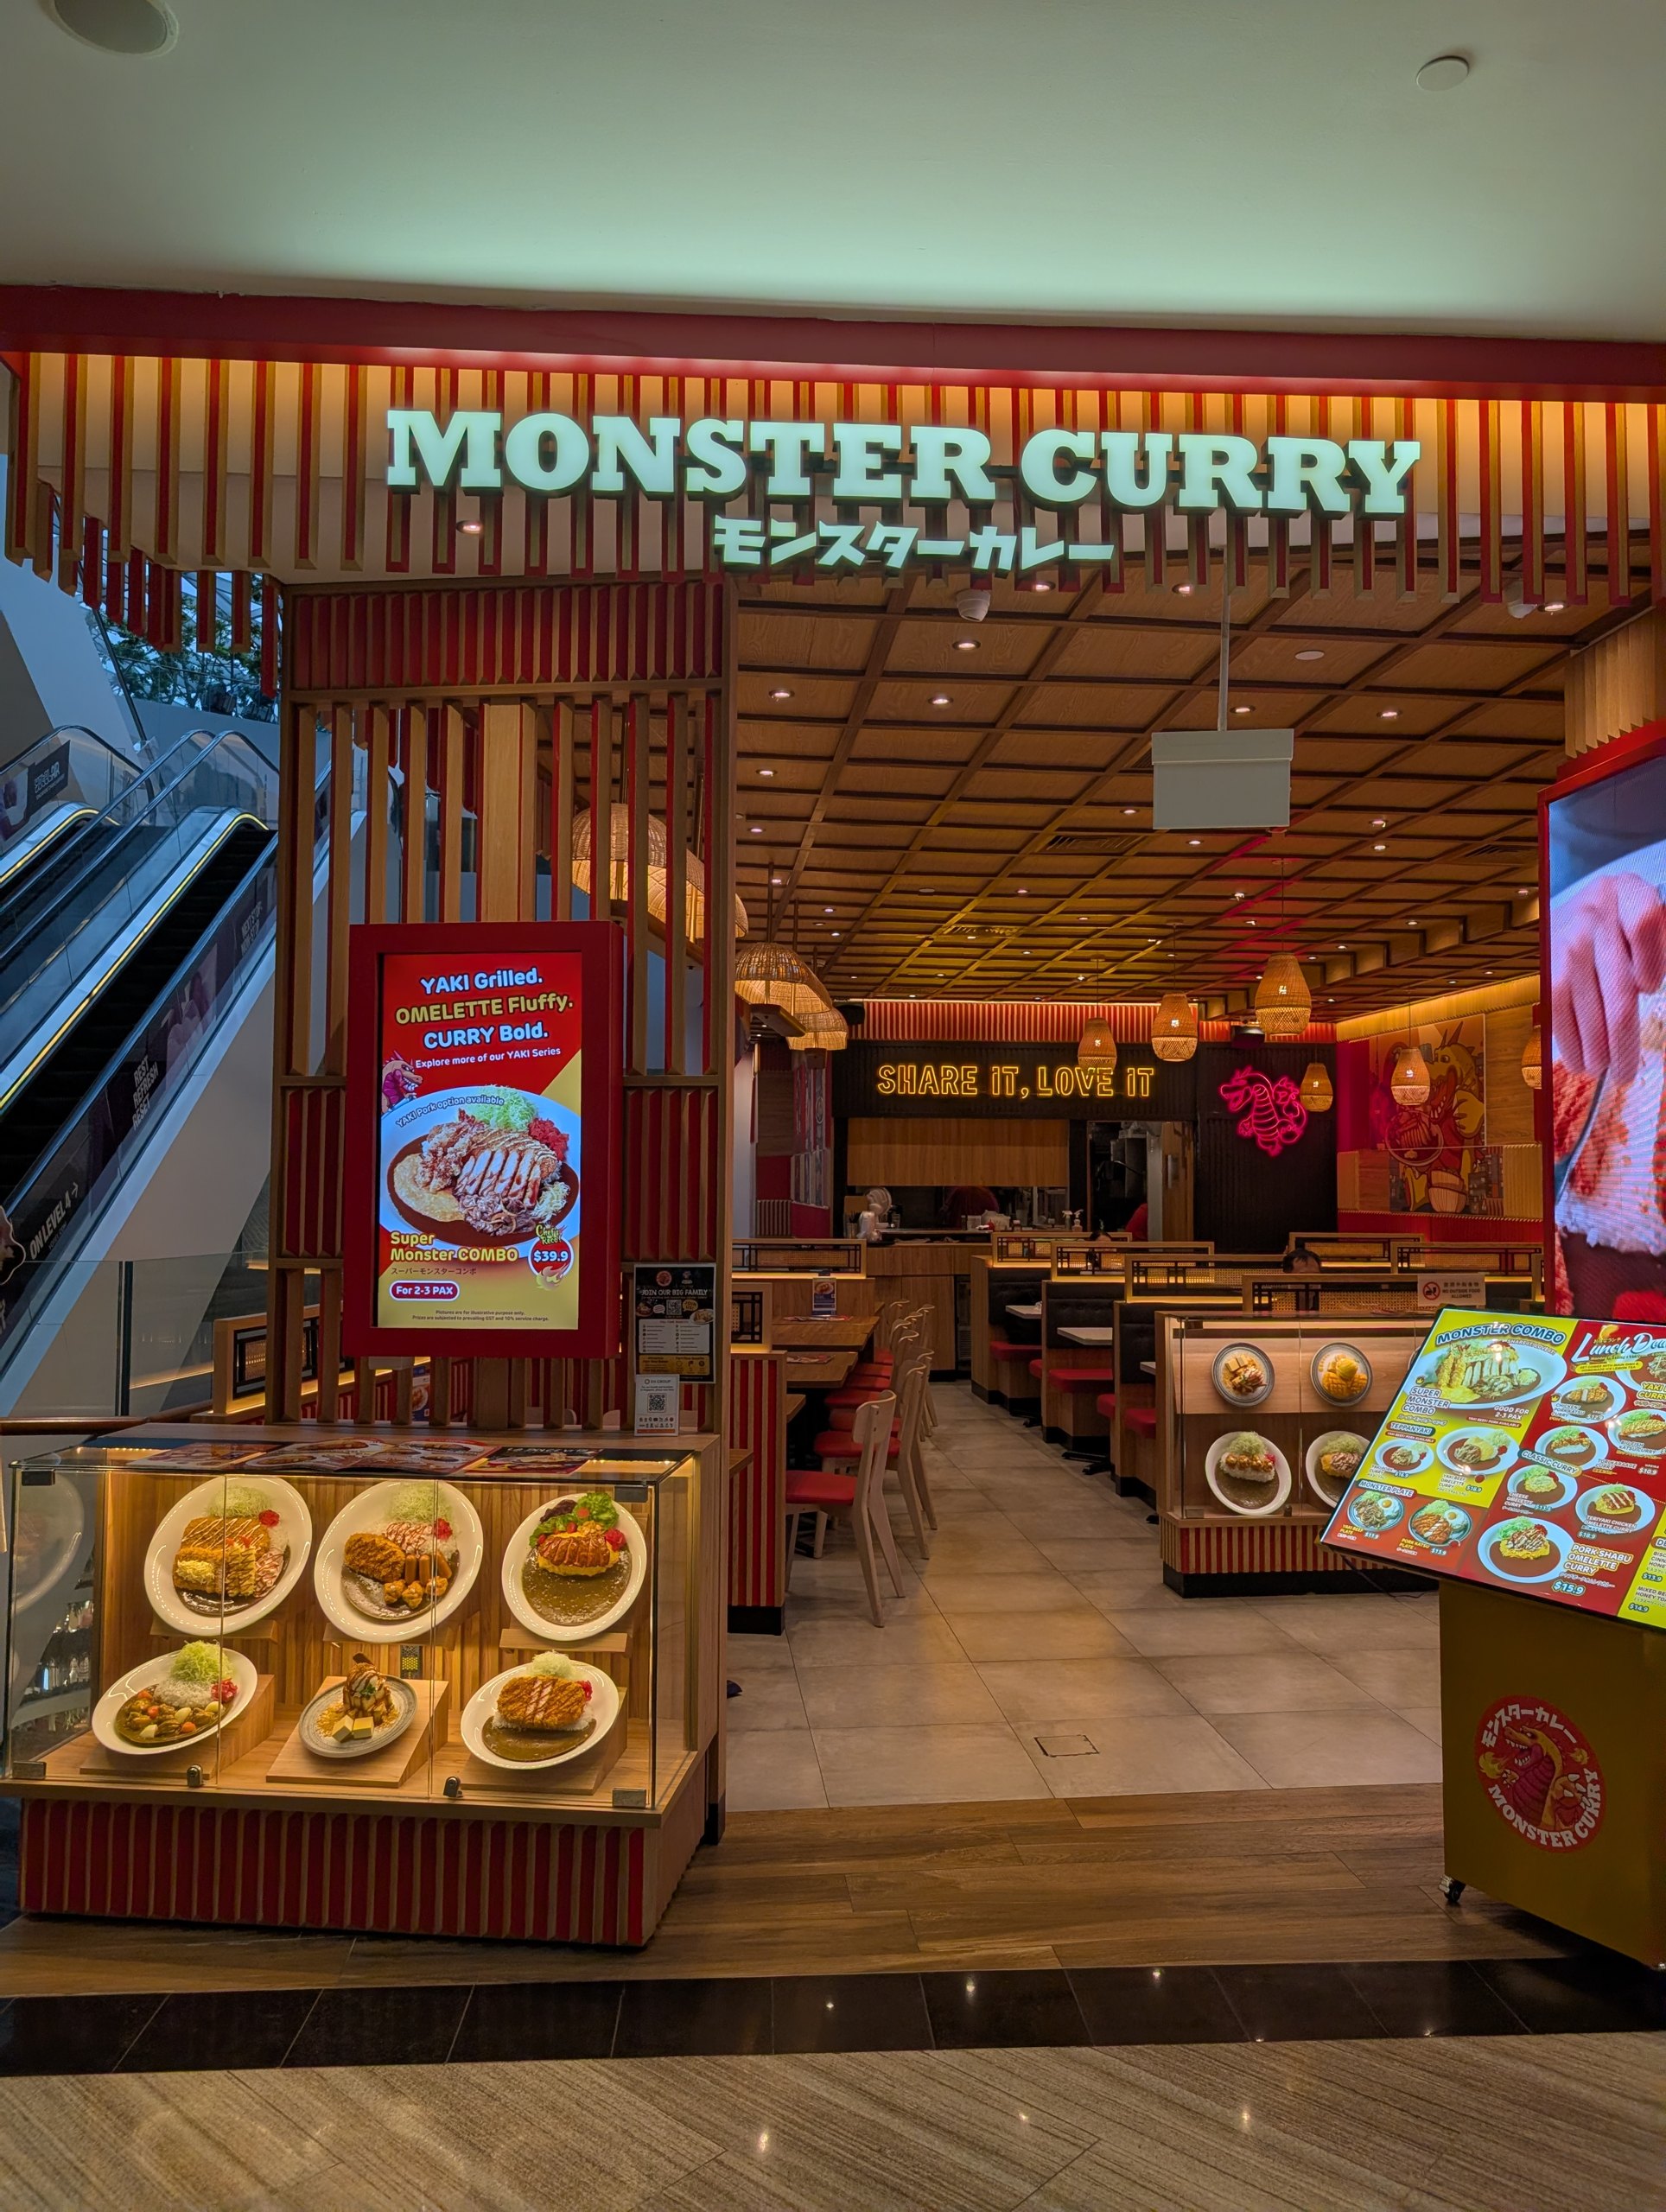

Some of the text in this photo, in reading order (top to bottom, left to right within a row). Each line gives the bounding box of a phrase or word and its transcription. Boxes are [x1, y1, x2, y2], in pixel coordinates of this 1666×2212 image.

[388, 410, 1421, 515] MONSTER CURRY
[714, 518, 1115, 573] モンスターカレー
[420, 967, 543, 995] YAKI Grilled.
[396, 993, 574, 1024] OMELETTE Fluffy.
[423, 1021, 549, 1049] CURRY Bold.
[416, 1058, 450, 1069] Explore
[452, 1056, 475, 1065] more
[477, 1053, 487, 1062] of
[506, 1050, 530, 1059] YAKI
[532, 1047, 561, 1056] Series
[134, 1054, 149, 1087] REST
[132, 1061, 158, 1109] REFRESH
[877, 1065, 1154, 1100] SHARE IT, LOVE IT
[132, 1092, 149, 1130] RESET
[397, 1095, 505, 1128] YAKI Pork option available
[29, 1230, 43, 1260] ON
[42, 1200, 67, 1243] LEVEL
[65, 1190, 71, 1210] 4
[391, 1232, 435, 1247] Super
[391, 1248, 518, 1262] Monster COMBO
[533, 1249, 569, 1262] $39.9
[396, 1286, 453, 1295] For 2-3 PAX
[1437, 1324, 1566, 1344] MONSTER COMBO
[1571, 1332, 1631, 1363] Lunch
[1411, 1387, 1440, 1397] SUPER
[1642, 1382, 1663, 1391] YAKI
[1403, 1404, 1435, 1415] COMBO
[1407, 1395, 1449, 1408] MONSTER
[1390, 1422, 1432, 1434] TEPPANYAKI
[1522, 1451, 1553, 1465] CLASSIC
[1554, 1462, 1577, 1473] CURRY
[1358, 1481, 1414, 1497] MONSTER PLATE
[1584, 1520, 1613, 1529] OMELETTE
[1587, 1515, 1637, 1529] TERIYAKI CHICKEN
[1568, 1554, 1618, 1569] OMELETTE
[1573, 1544, 1632, 1563] PORK SHABU
[1564, 1562, 1597, 1574] CURRY
[1554, 1580, 1584, 1595] $15.9
[1637, 1586, 1656, 1594] MIXED
[1481, 1703, 1577, 1748] モンスターカレー
[1488, 1768, 1601, 1847] MONSTER CURRY
